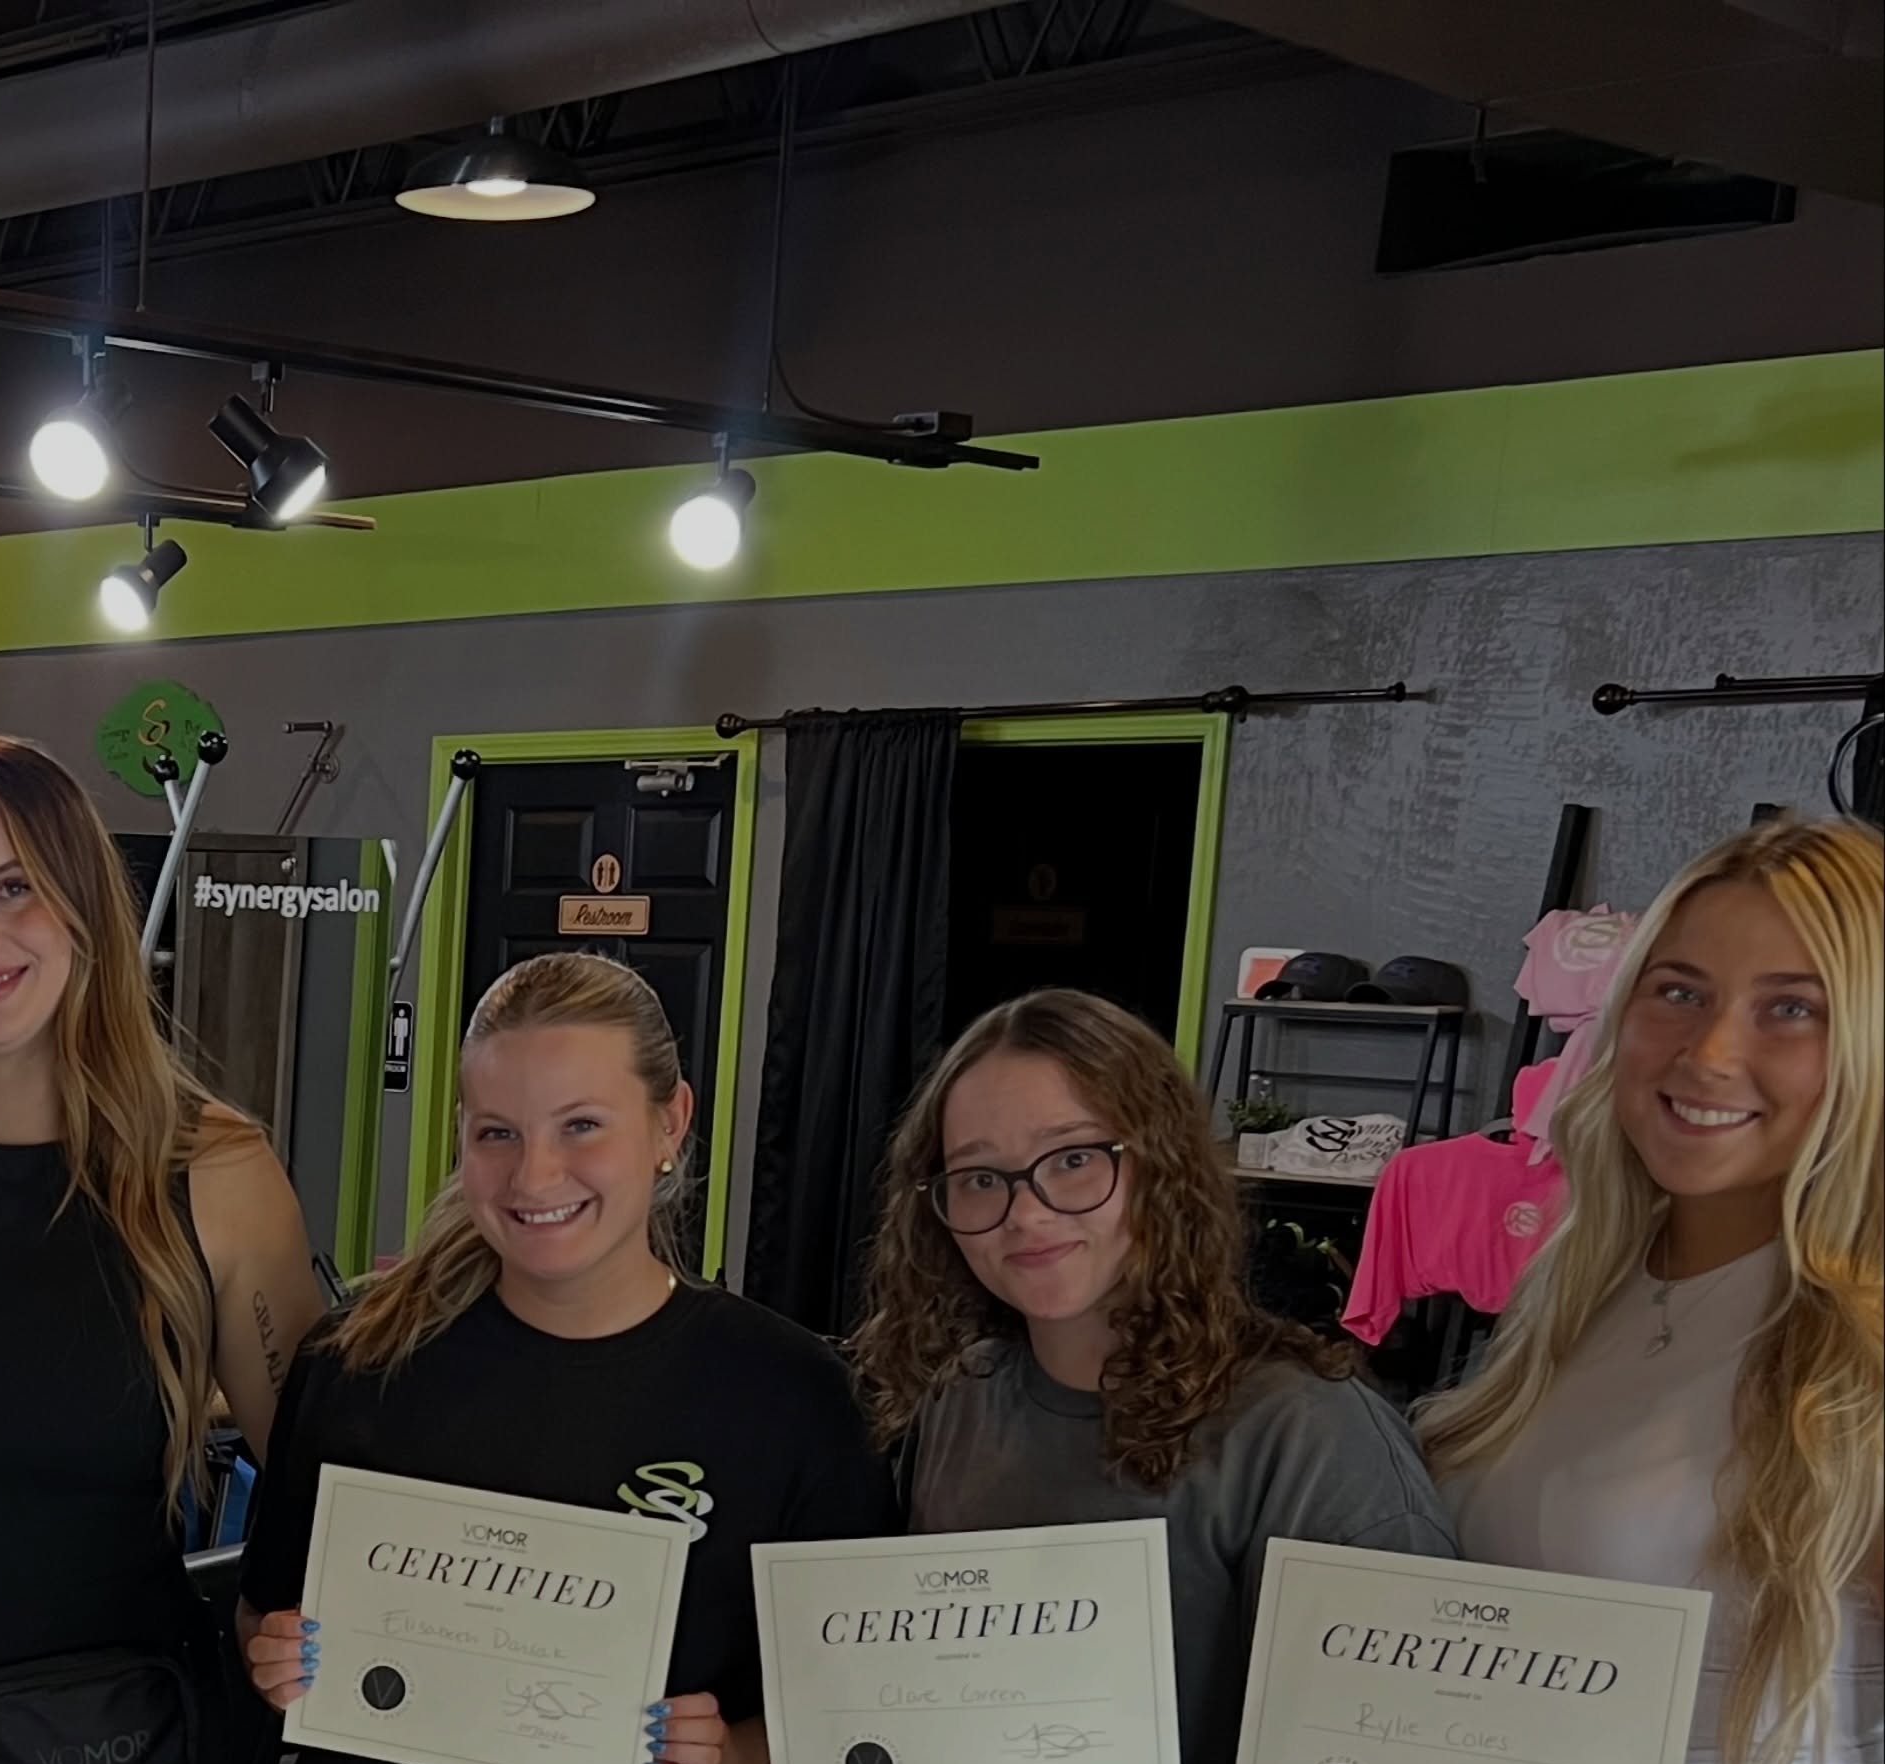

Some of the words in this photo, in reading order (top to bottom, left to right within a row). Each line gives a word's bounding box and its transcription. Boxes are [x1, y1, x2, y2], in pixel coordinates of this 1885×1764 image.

[193, 874, 380, 919] #synergysalon
[573, 903, 633, 926] Restroom
[461, 1522, 529, 1548] VOMOR
[367, 1541, 616, 1611] CERTIFIED
[914, 1568, 990, 1589] VOMOR
[821, 1597, 1099, 1646] CERTIFIED
[1432, 1598, 1511, 1626] VOMOR
[1320, 1622, 1619, 1697] CERTIFIED
